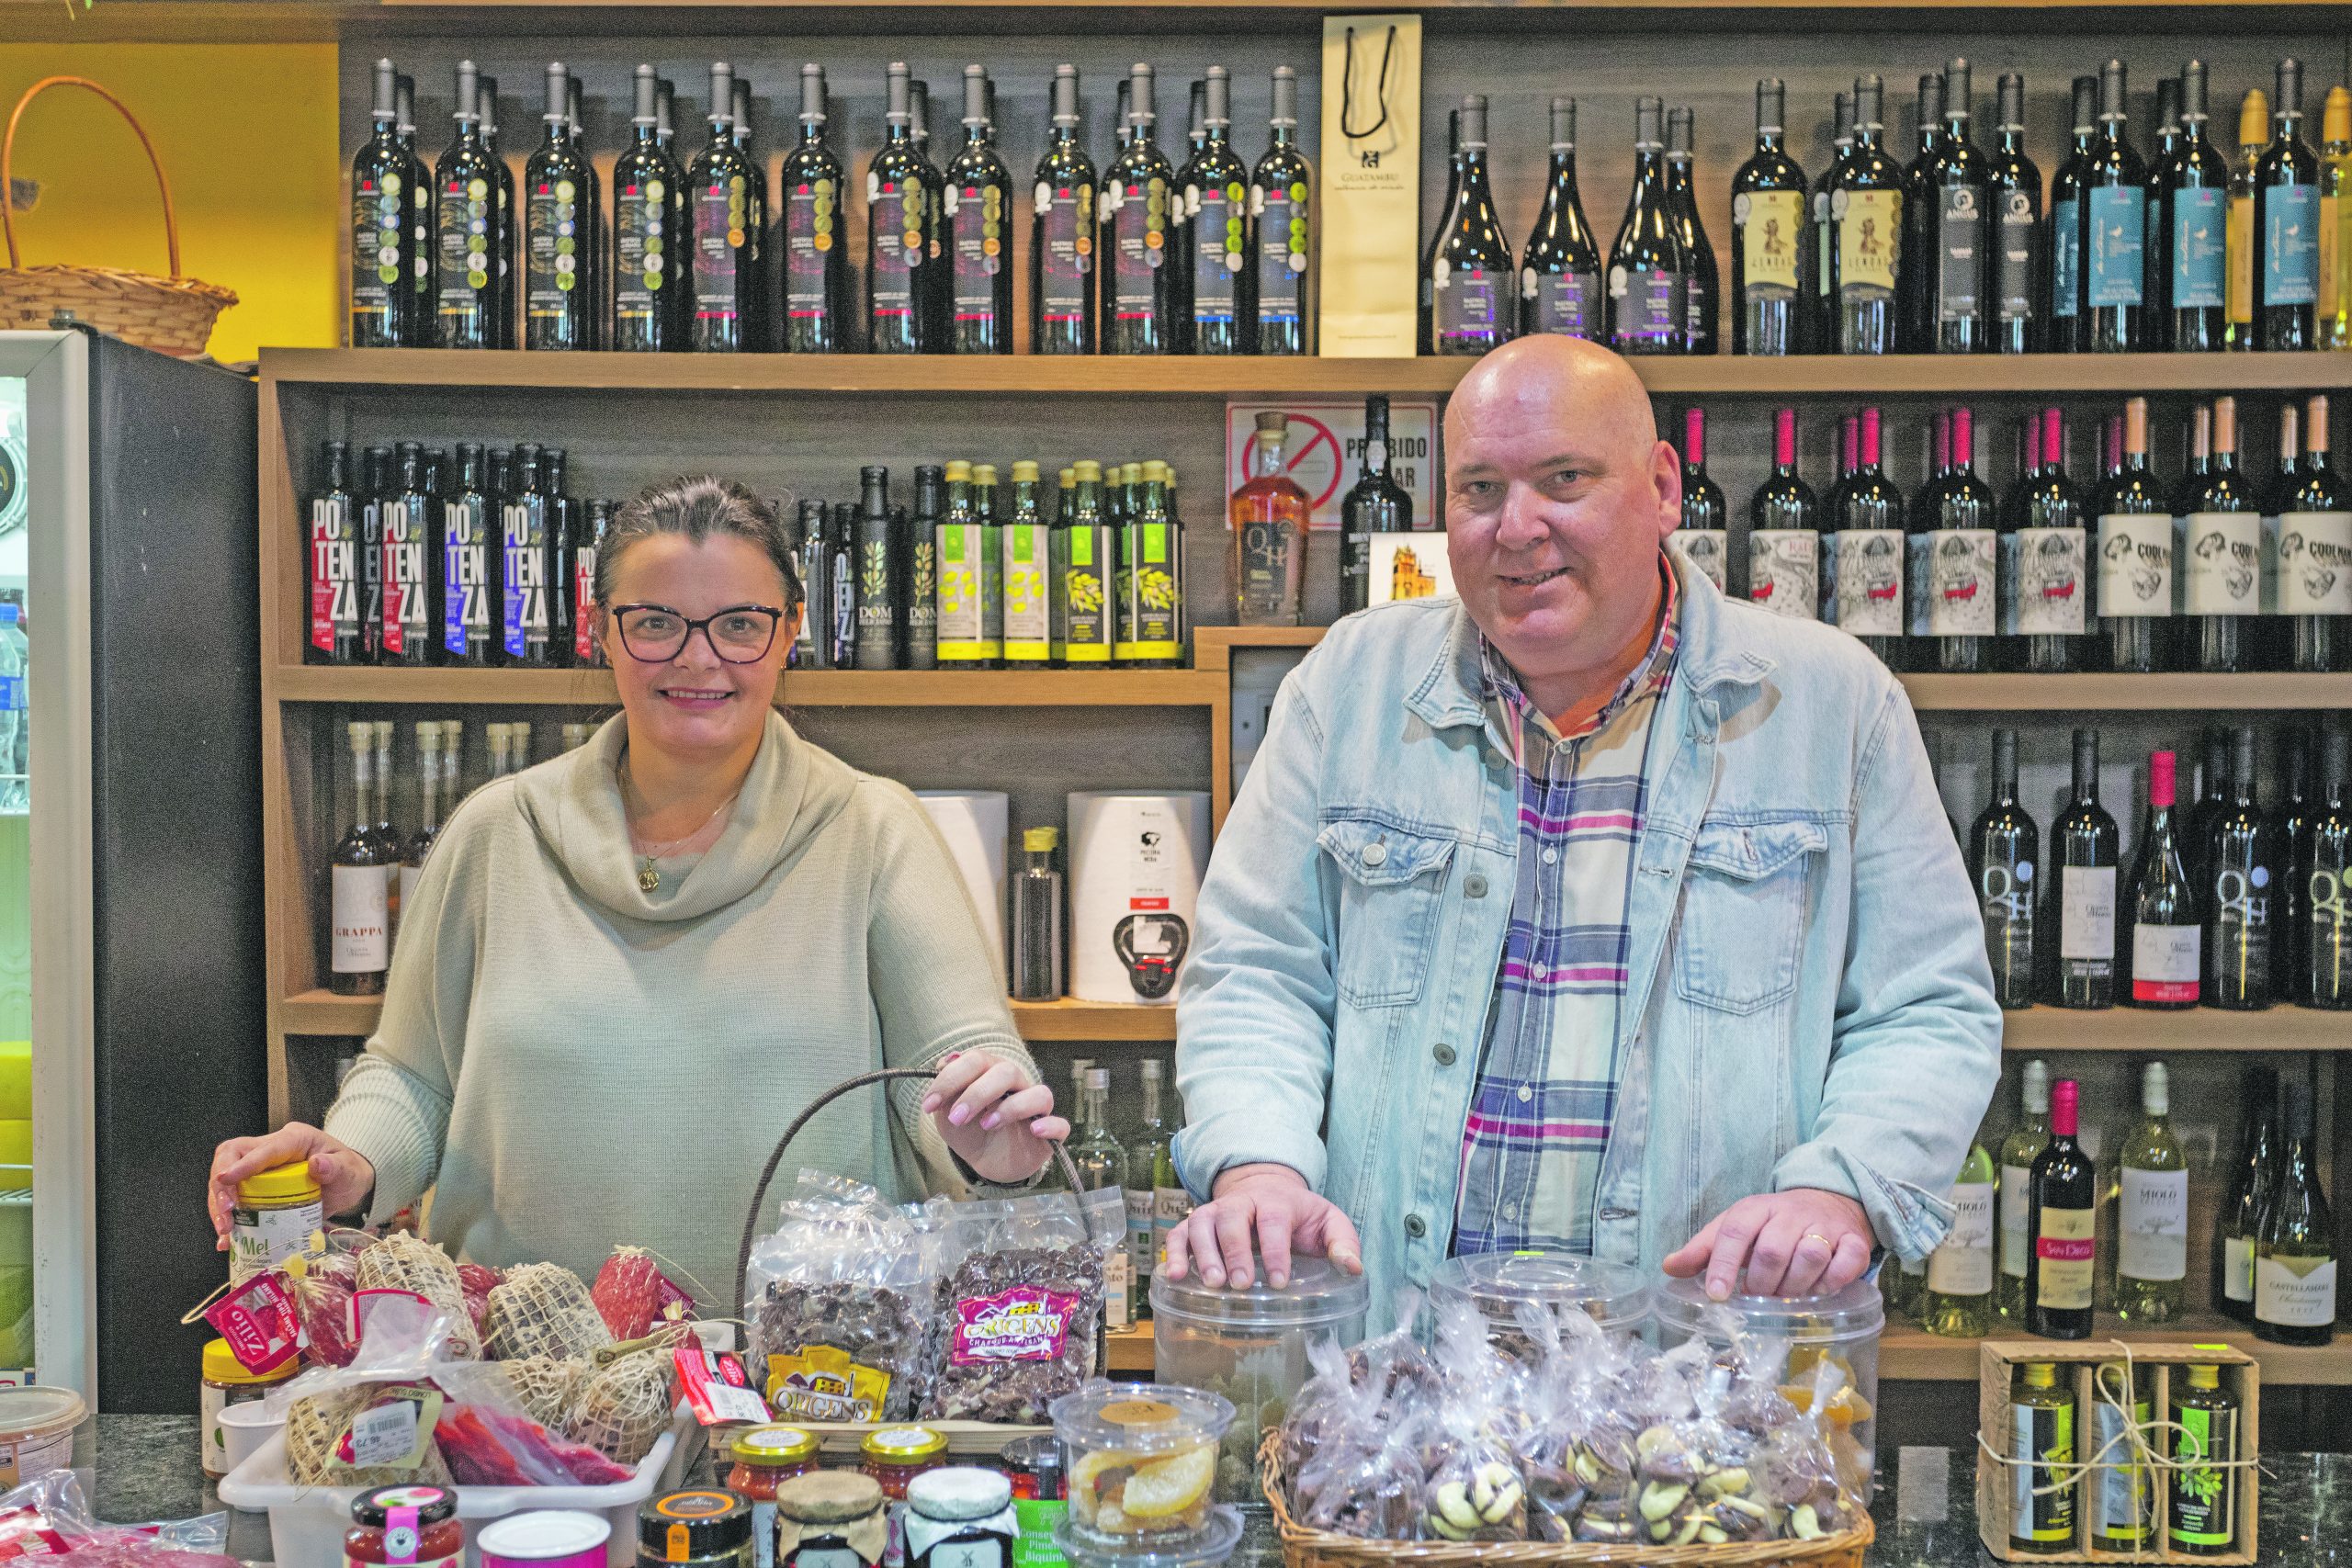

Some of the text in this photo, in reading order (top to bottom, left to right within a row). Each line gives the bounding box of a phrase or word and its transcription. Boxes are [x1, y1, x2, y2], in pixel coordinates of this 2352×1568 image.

[1347, 437, 1426, 458] PRBIDO
[313, 499, 340, 540] PO
[383, 501, 407, 543] PO
[446, 503, 470, 545] PO
[504, 505, 528, 547] PO
[316, 540, 354, 581] TEN
[385, 543, 423, 582] TEN
[447, 545, 485, 585] TEN
[506, 547, 544, 587] TEN
[330, 581, 358, 621] ZA
[398, 583, 427, 624] ZA
[461, 585, 490, 625] ZA
[520, 588, 548, 627] ZA
[859, 606, 892, 620] DOM
[335, 926, 383, 937] GRAPPA
[241, 1235, 270, 1257] Mel
[232, 1310, 266, 1355] Zilio
[967, 1315, 1059, 1337] ORIGENS
[775, 1390, 871, 1421] ORIGENS
